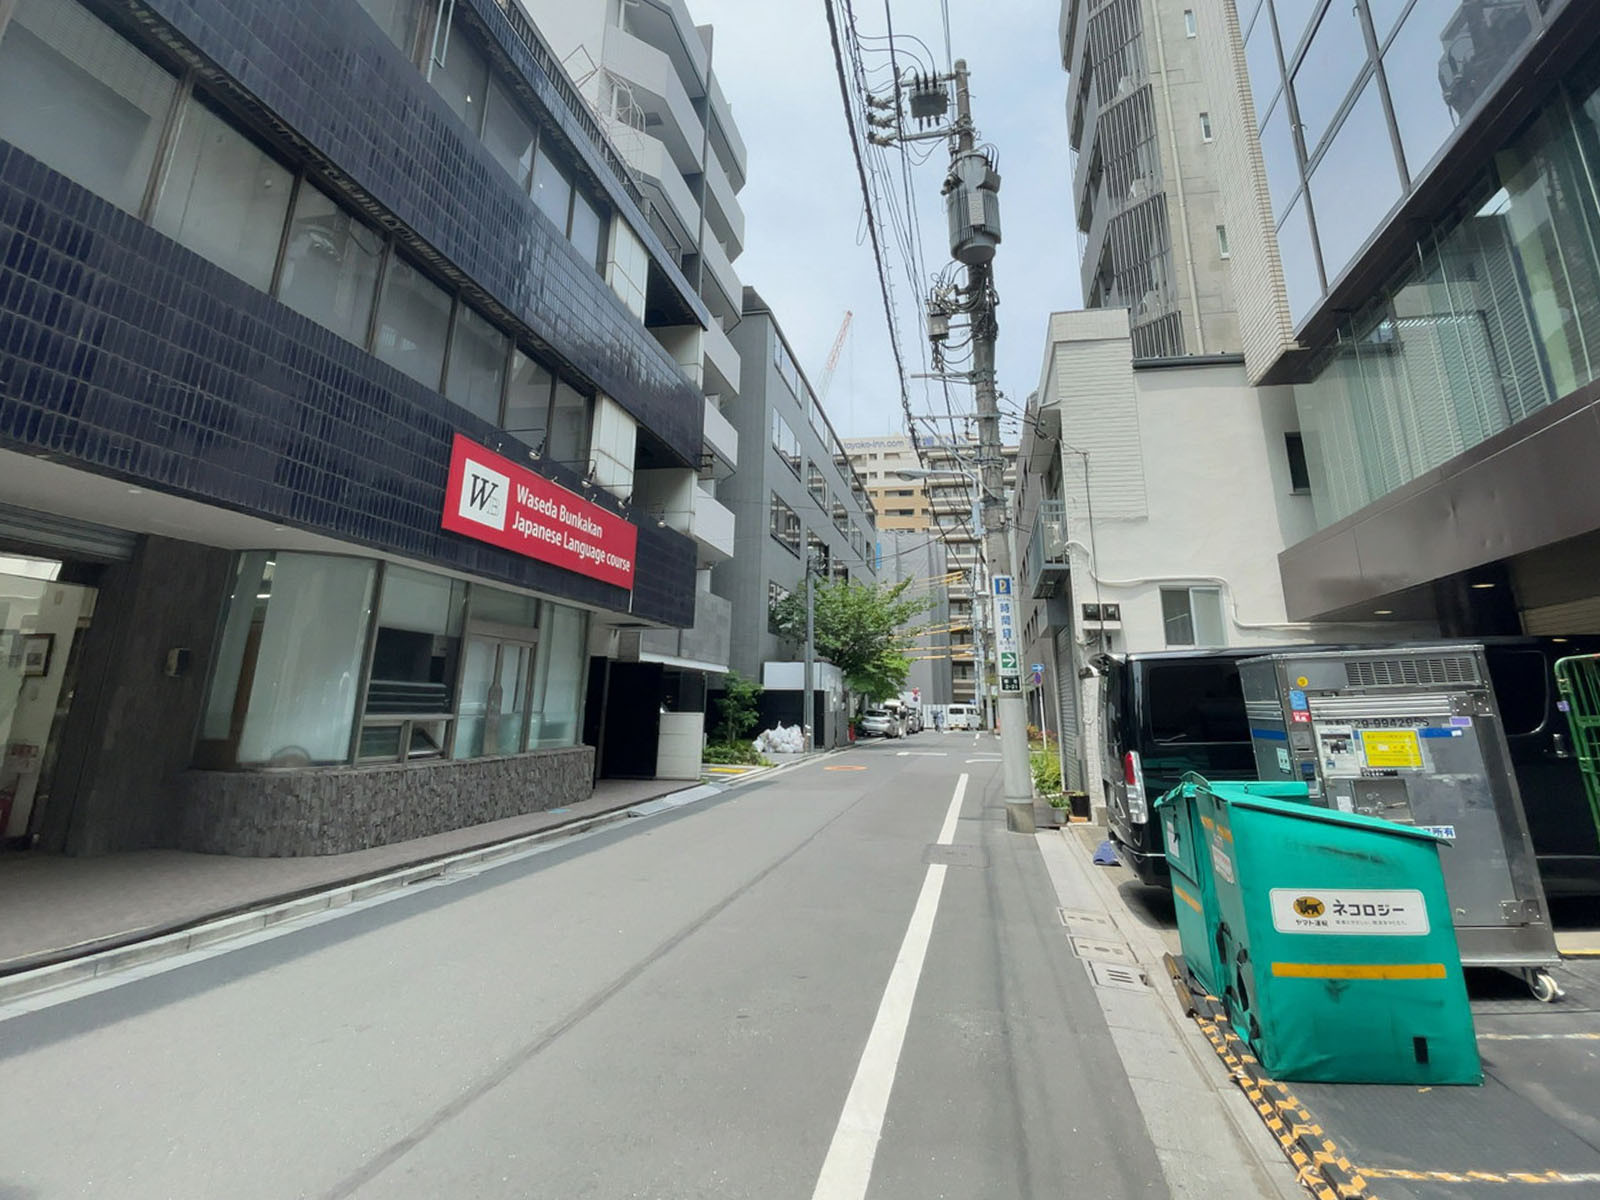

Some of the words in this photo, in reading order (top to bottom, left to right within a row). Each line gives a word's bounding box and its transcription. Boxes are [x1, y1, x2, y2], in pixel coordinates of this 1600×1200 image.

[516, 483, 558, 519] Waseda
[559, 504, 604, 539] Bunkakan
[512, 513, 562, 546] Japanese
[563, 531, 606, 566] Language
[606, 553, 631, 572] course
[1333, 899, 1405, 917] ネコロジー
